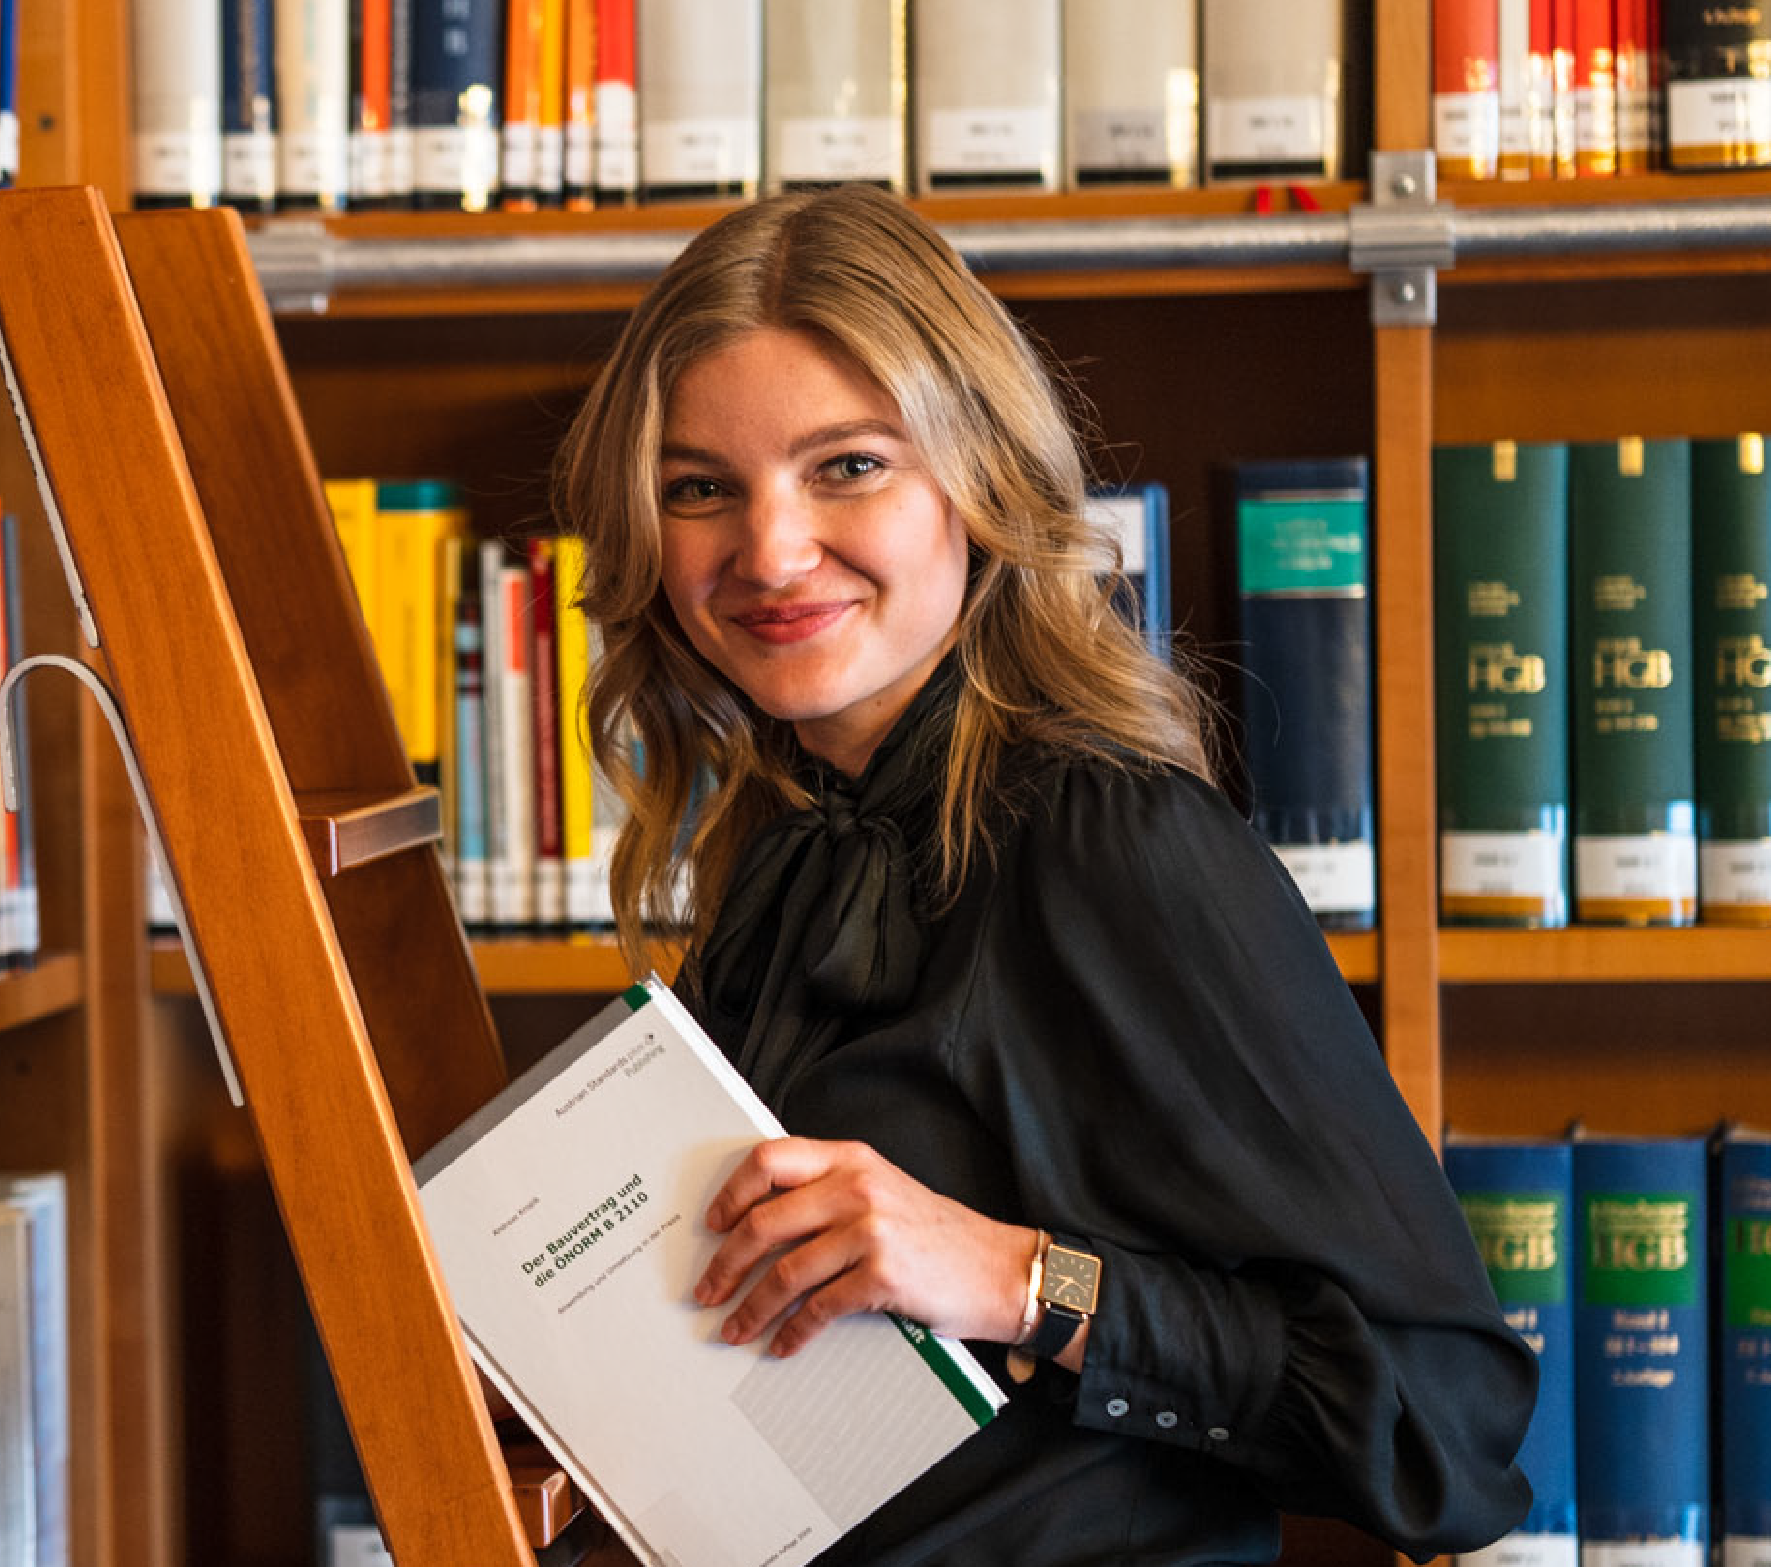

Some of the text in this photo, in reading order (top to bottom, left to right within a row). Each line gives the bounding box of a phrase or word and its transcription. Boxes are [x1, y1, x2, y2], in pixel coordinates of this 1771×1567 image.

[1468, 654, 1546, 693] HGB
[1594, 650, 1673, 689] HGB
[555, 1088, 588, 1118] Austrian
[586, 1057, 629, 1092] Standards
[521, 1173, 642, 1274] Der Bauvertrag und
[534, 1191, 648, 1287] die ÖNORM B 2110
